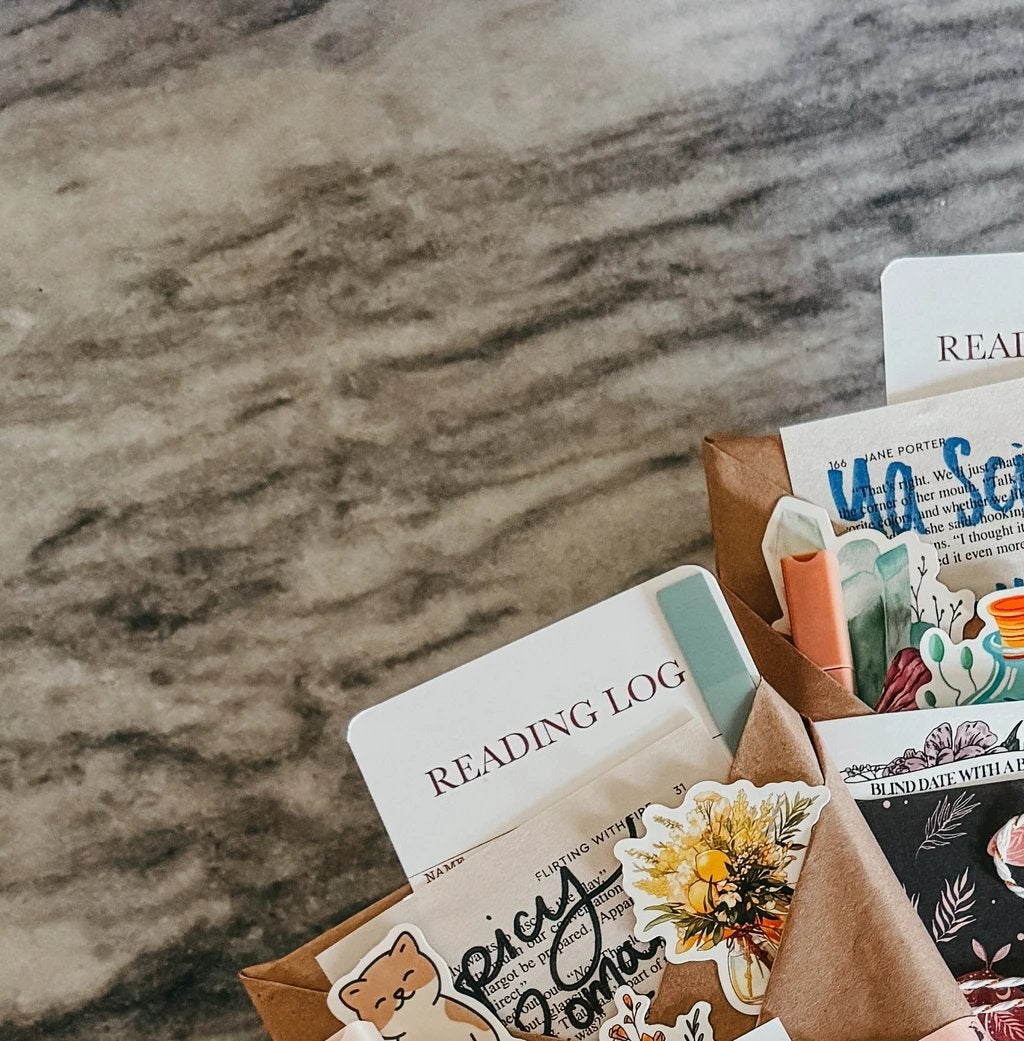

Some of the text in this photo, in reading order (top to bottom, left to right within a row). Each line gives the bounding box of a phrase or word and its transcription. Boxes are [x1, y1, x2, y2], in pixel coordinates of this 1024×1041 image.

[829, 438, 946, 470] 166 JANE PORTER
[861, 499, 897, 515] corner
[901, 494, 914, 507] of
[916, 490, 936, 503] her
[939, 482, 979, 499] mouth.
[920, 505, 939, 519] and
[942, 498, 988, 514] whether
[993, 494, 1008, 505] we
[926, 523, 945, 535] she
[948, 515, 976, 530] said,
[969, 525, 1014, 543] thought
[953, 551, 962, 563] it
[965, 547, 993, 560] even
[424, 659, 687, 797] READING LOG
[870, 776, 917, 795] BLIND
[918, 771, 957, 792] DATE
[958, 763, 1002, 783] WITH
[1003, 760, 1016, 774] A
[535, 842, 590, 881] FLIRTING
[592, 820, 627, 846] WITH
[673, 782, 687, 796] 31
[454, 864, 622, 1013] picy
[527, 931, 548, 948] our
[519, 959, 536, 973] be
[650, 957, 663, 974] of
